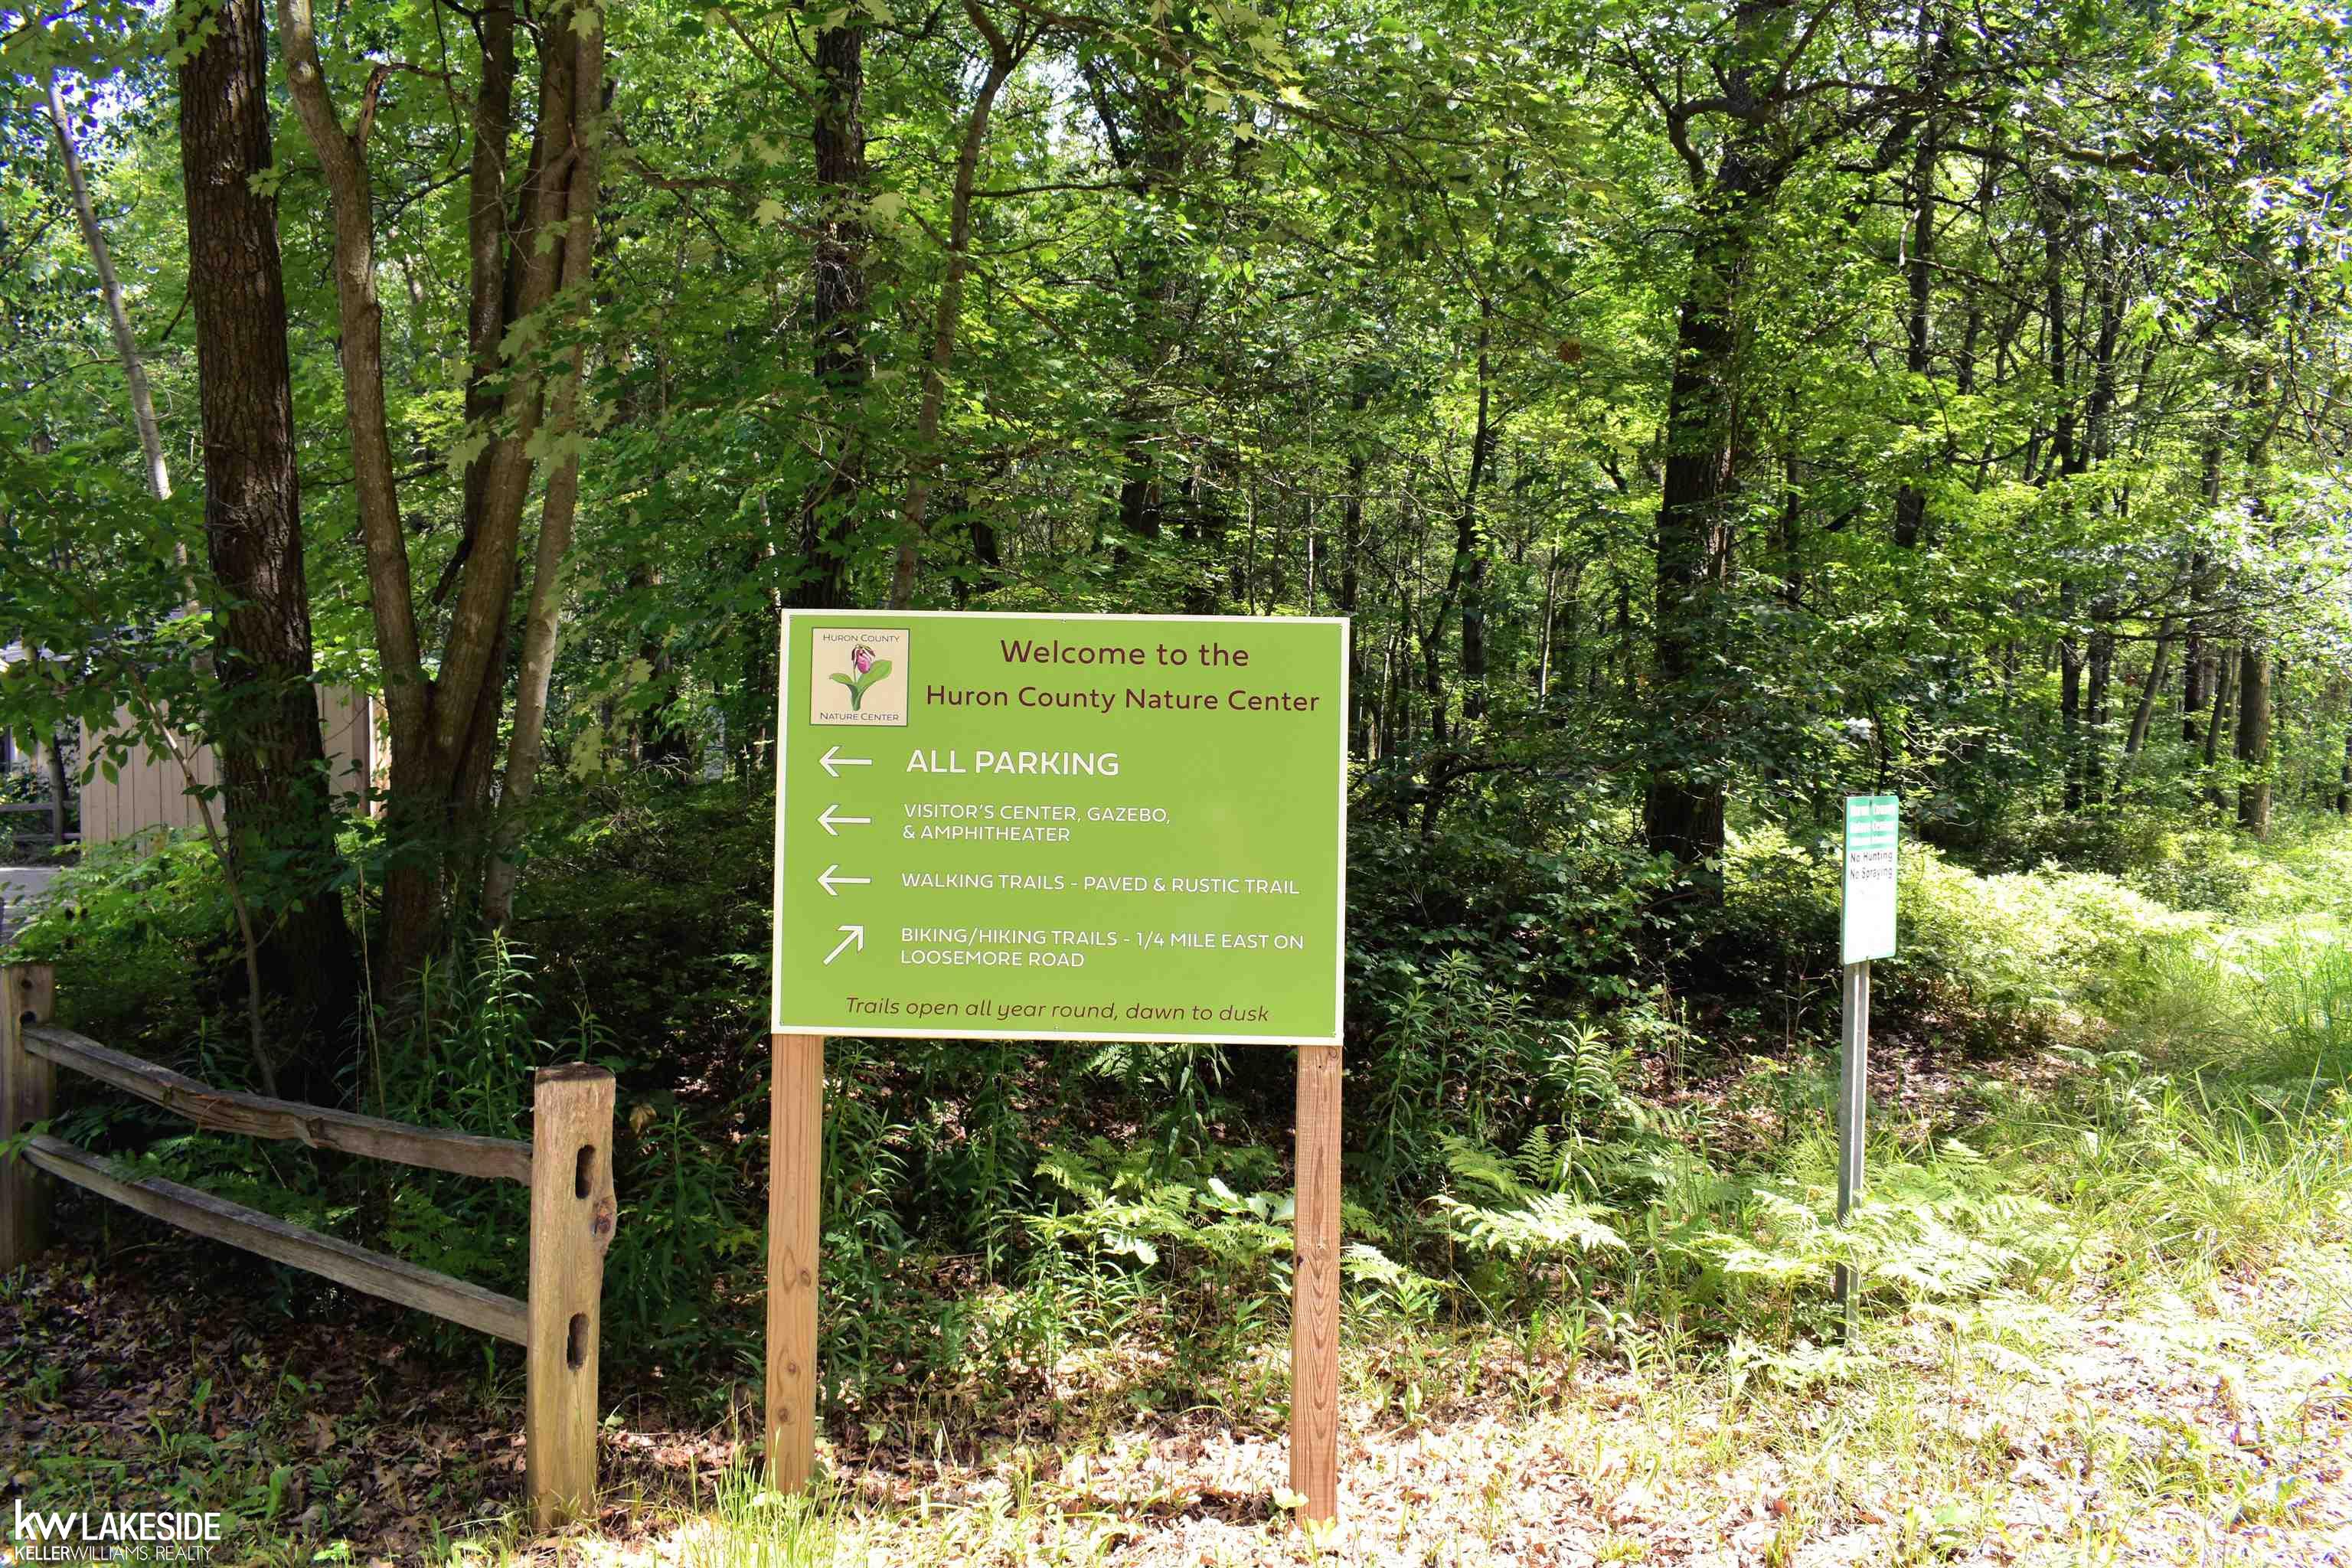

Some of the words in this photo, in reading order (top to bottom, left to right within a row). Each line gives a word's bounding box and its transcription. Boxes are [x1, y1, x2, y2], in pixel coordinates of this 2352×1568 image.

[823, 634, 858, 642] HURON
[861, 635, 900, 643] COUNTY
[1000, 639, 1145, 665] Welcome
[1156, 643, 1187, 666] to
[1198, 642, 1250, 667] the
[926, 684, 1008, 707] Huron
[1018, 686, 1116, 714] County
[1125, 688, 1219, 710] Nature
[1228, 690, 1320, 711] Center
[906, 749, 967, 773] ALL
[975, 750, 1120, 776] PARKING
[904, 803, 995, 819] VISITOR'S
[1000, 805, 1081, 822] CENTER,
[1086, 807, 1171, 825] GAZEBO,
[903, 825, 916, 839] &
[920, 825, 1070, 841] AMPHITHEATER
[1850, 853, 1860, 863] No
[1863, 851, 1893, 862] Hunting
[901, 873, 993, 889] WALKING
[998, 874, 1065, 890] TRAILS
[1084, 876, 1148, 892] PAVED
[1153, 877, 1166, 892] &
[1171, 877, 1240, 893] RUSTIC
[1244, 877, 1299, 895] TRAIL
[1850, 869, 1860, 880] No
[1862, 867, 1893, 881] Spraying
[901, 927, 1046, 947] BIKING/HIKING
[1050, 930, 1118, 947] TRAILS
[1136, 931, 1165, 950] 1/4
[1169, 933, 1217, 949] MILE
[1220, 933, 1269, 949] EAST
[1273, 935, 1305, 950] ON
[900, 949, 1023, 967] LOOSEMORE
[1028, 952, 1085, 968] ROAD
[846, 997, 900, 1016] Trails
[906, 1001, 959, 1021] open
[965, 999, 992, 1017] all
[997, 1004, 1047, 1021] year
[1052, 1002, 1118, 1021] round,
[1125, 1002, 1185, 1021] dawn
[1192, 1005, 1213, 1021] to
[1219, 1004, 1269, 1022] dusk
